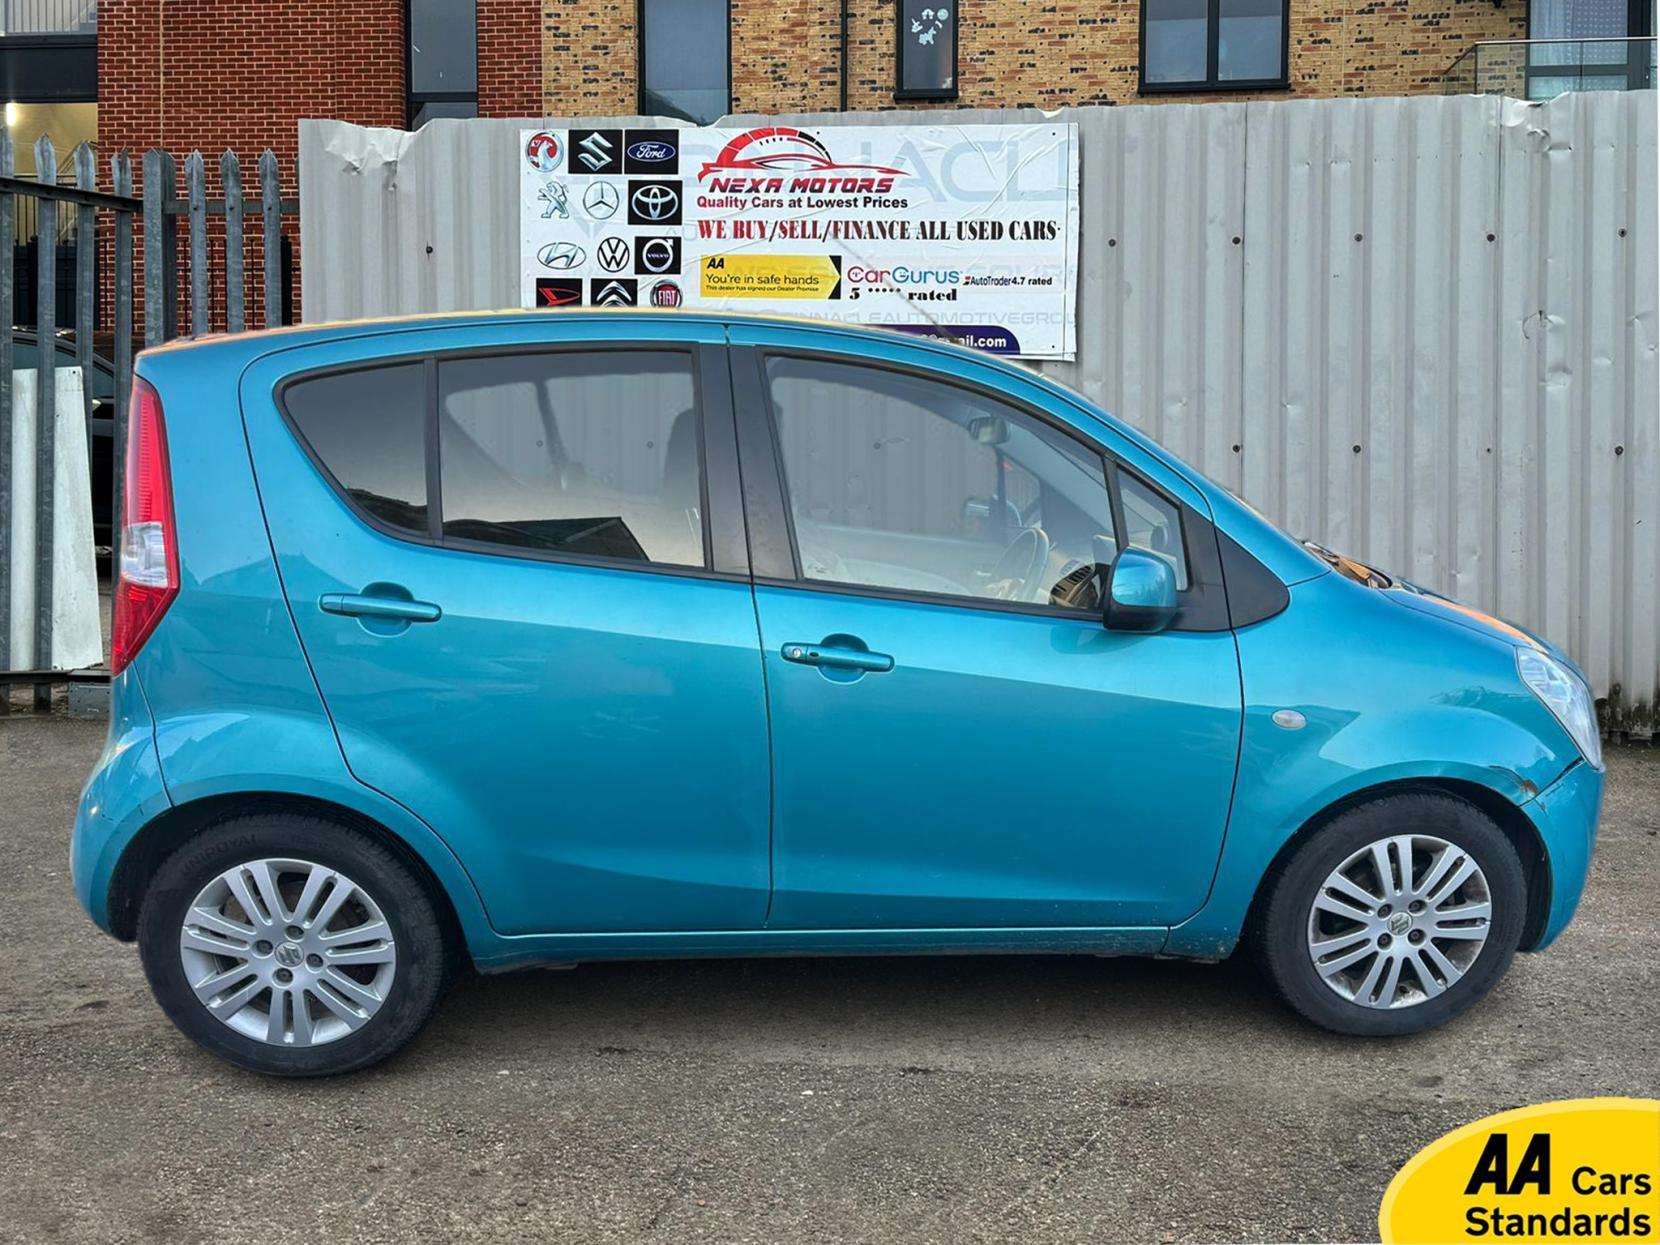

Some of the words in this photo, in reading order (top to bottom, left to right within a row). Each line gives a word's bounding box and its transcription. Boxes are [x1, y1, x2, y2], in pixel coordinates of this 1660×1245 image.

[636, 144, 666, 159] Ford
[709, 178, 783, 194] NEXA
[789, 178, 894, 194] MOTORS
[697, 196, 747, 210] Quality
[752, 196, 784, 208] Cars
[788, 196, 802, 208] at
[807, 196, 858, 208] Lowest
[863, 196, 908, 208] Prices
[697, 220, 726, 239] WE
[733, 220, 911, 242] BUY/SELL/FINANCE
[916, 221, 951, 240] ALL
[957, 221, 1003, 240] USED
[1009, 221, 1056, 240] CARS
[707, 257, 725, 269] AA
[706, 274, 741, 284] You're
[744, 274, 754, 284] in
[757, 274, 781, 284] safe
[784, 275, 819, 285] hands
[847, 265, 960, 283] CarGurus
[1028, 277, 1053, 285] rated
[658, 290, 676, 306] FIAT
[849, 287, 861, 300] 5
[908, 288, 957, 301] rated
